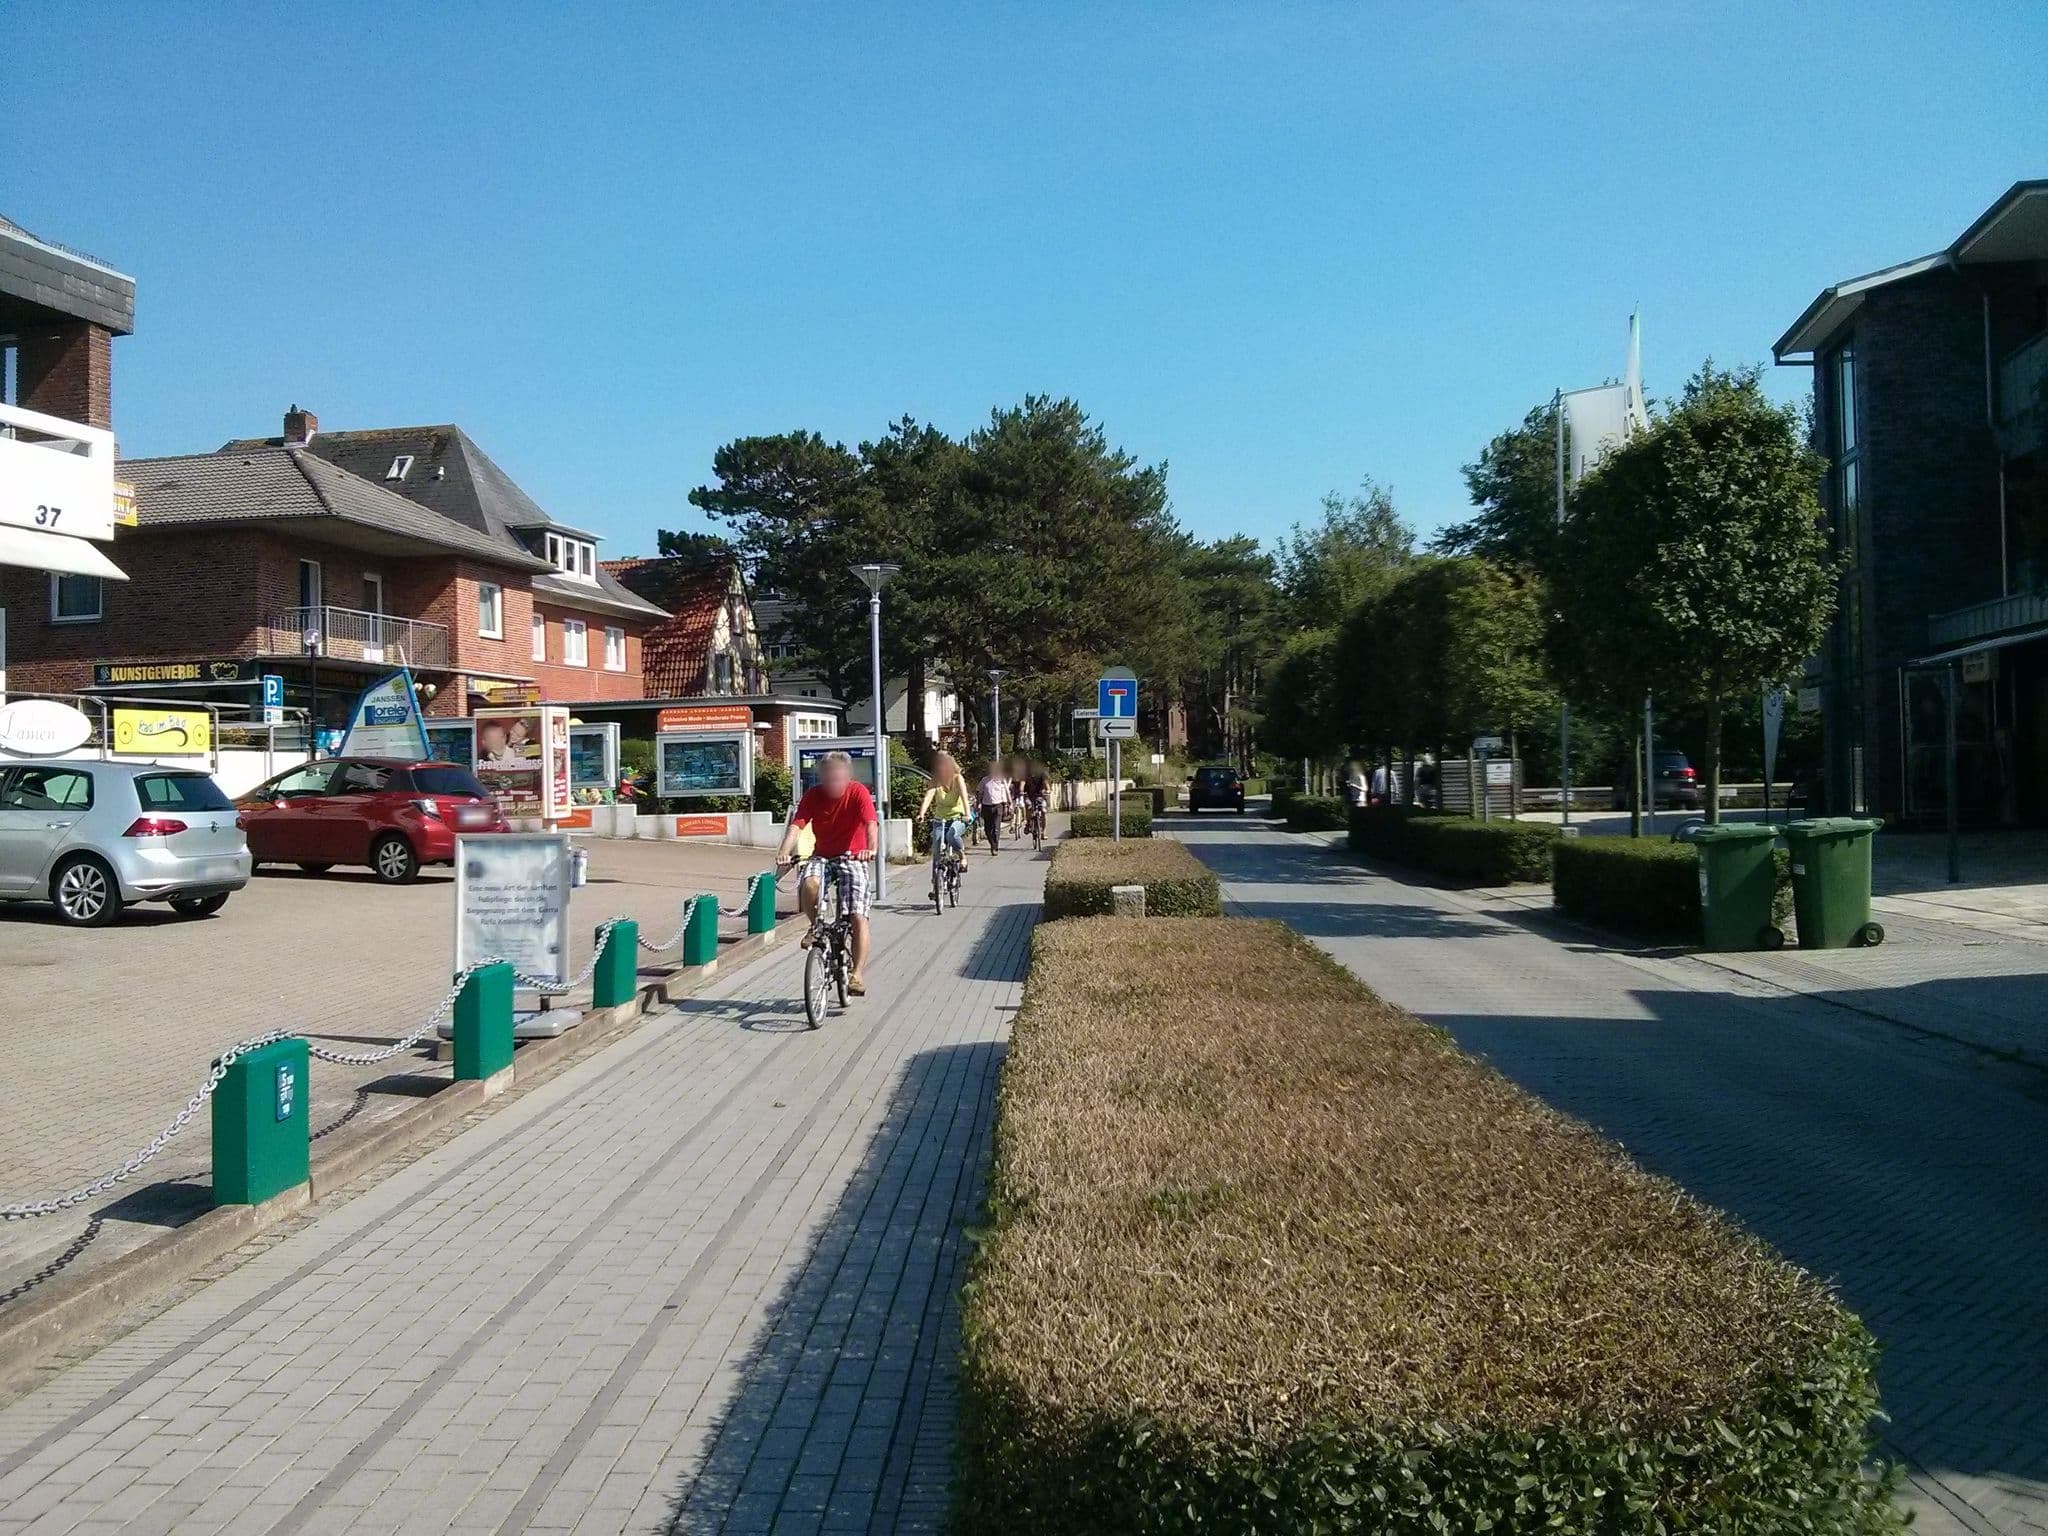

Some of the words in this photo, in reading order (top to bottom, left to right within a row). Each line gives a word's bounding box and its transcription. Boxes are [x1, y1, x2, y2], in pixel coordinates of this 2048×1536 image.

[35, 504, 62, 527] 37
[111, 664, 201, 681] KUNSTGEWERBE
[267, 679, 278, 703] P
